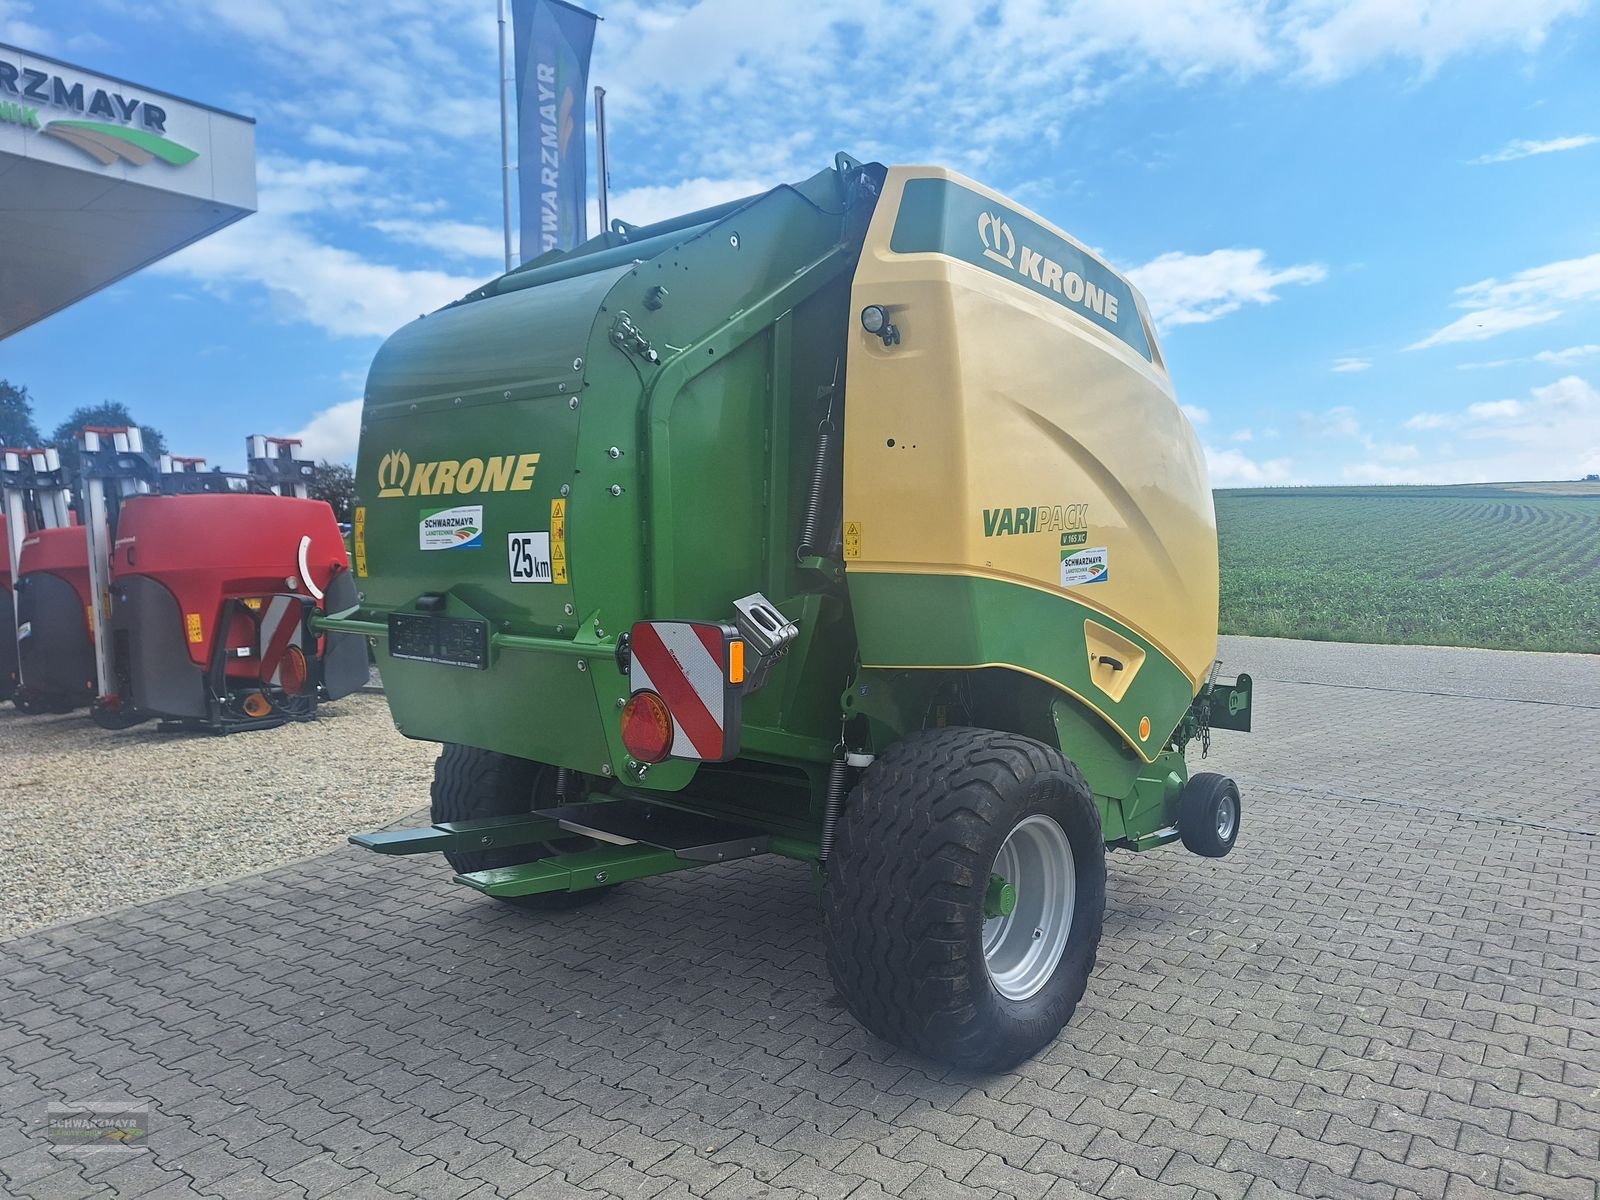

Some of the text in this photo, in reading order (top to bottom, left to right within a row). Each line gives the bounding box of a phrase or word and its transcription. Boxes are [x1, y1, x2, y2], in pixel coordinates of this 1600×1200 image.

[1019, 245, 1119, 323] KRONE
[408, 453, 541, 496] KRONE
[425, 517, 474, 528] SCHWARZMAYR
[983, 504, 1088, 537] VARIPACK
[512, 538, 549, 578] 25 km
[1065, 556, 1101, 567] SCHWARZMAYR
